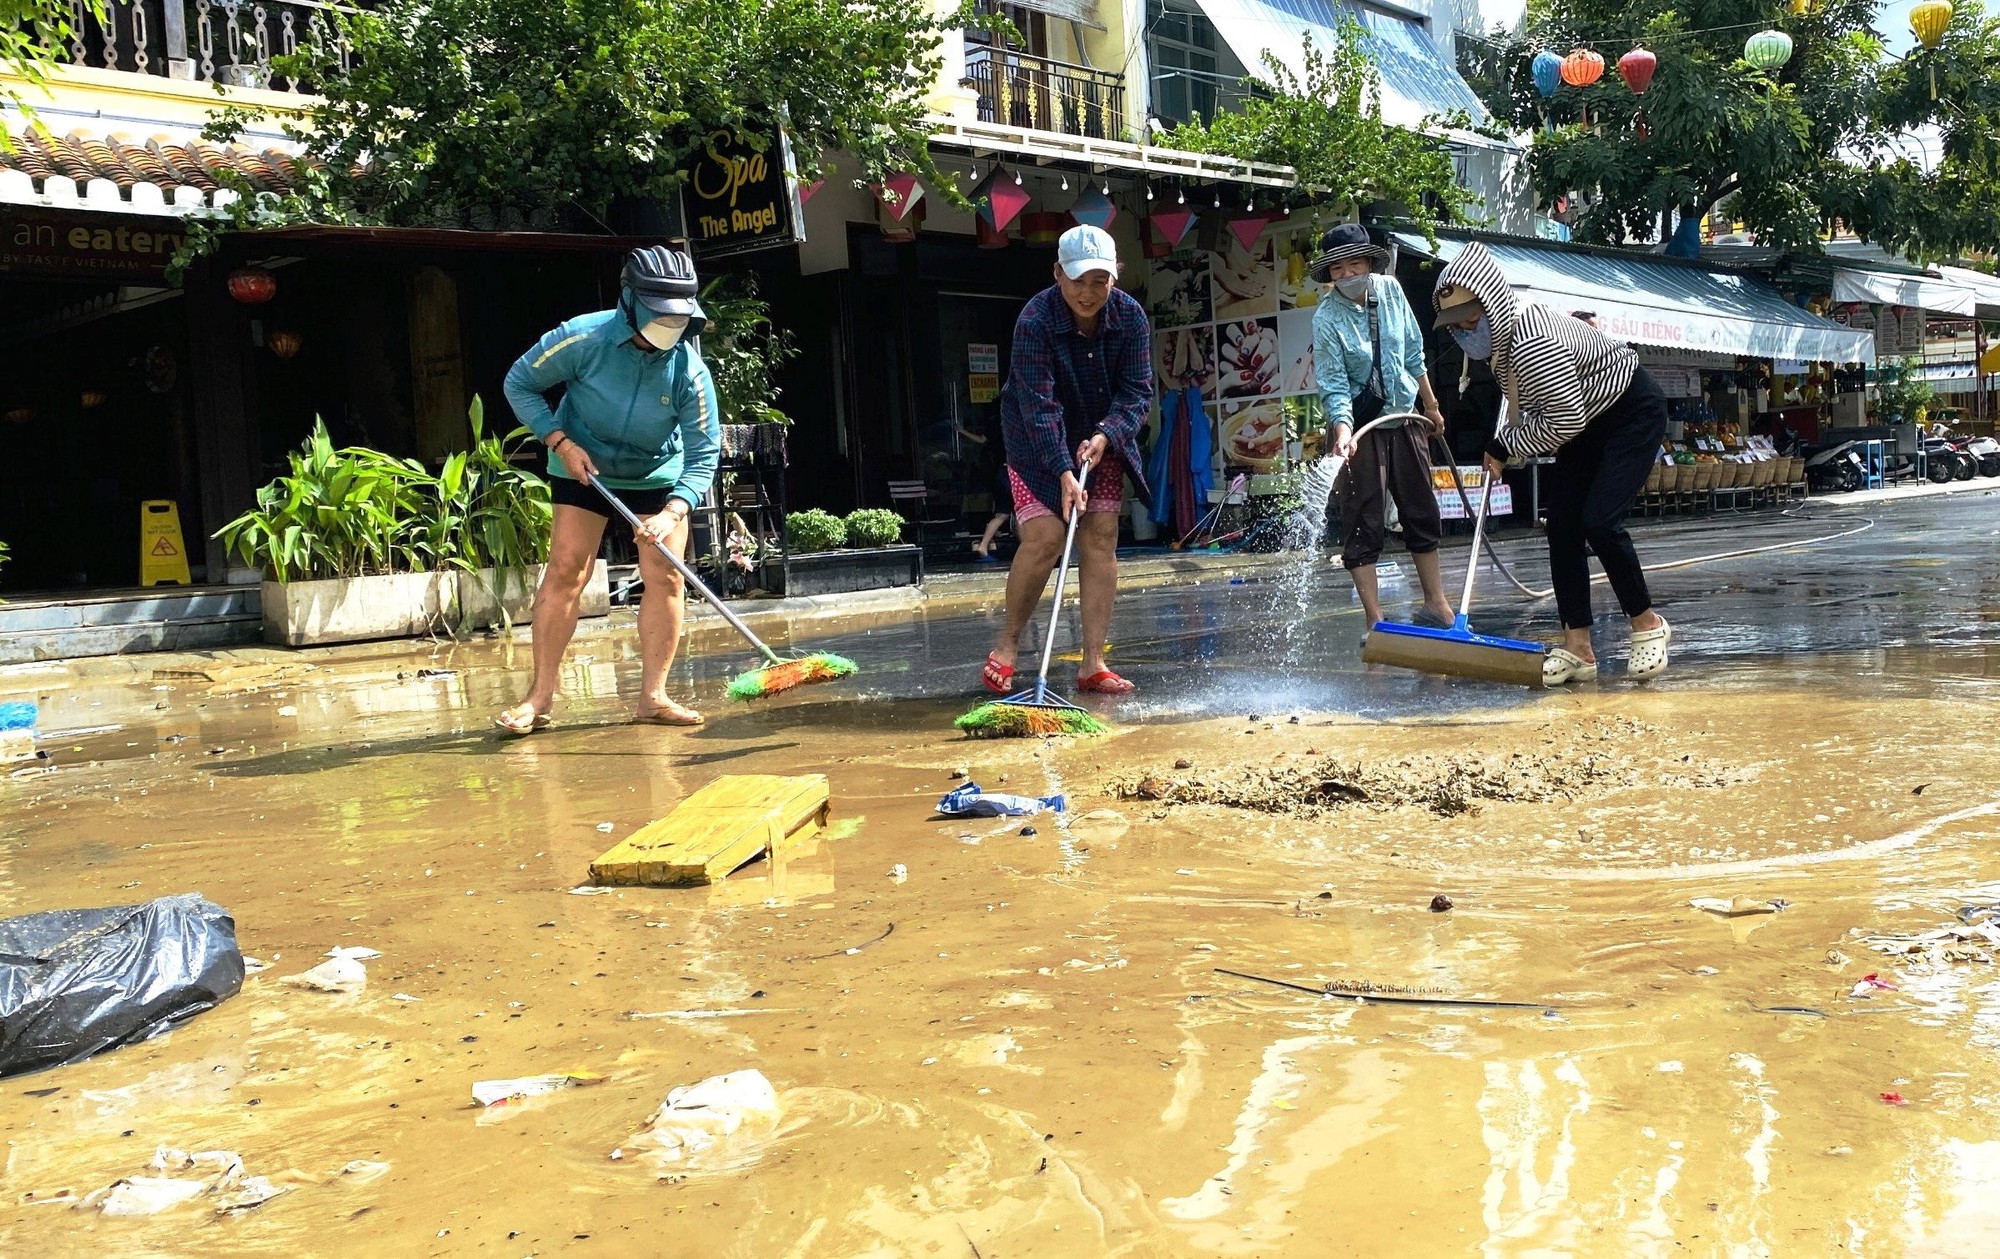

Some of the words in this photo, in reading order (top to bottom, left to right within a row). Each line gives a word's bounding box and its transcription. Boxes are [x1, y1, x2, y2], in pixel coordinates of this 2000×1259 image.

[694, 130, 768, 207] Spa
[699, 215, 728, 238] The
[732, 201, 777, 234] Angel
[13, 223, 56, 247] an
[67, 225, 190, 254] eatery
[2, 253, 19, 263] BY
[27, 254, 72, 266] TASTE
[75, 257, 139, 269] VIETNAM
[1612, 311, 1639, 337] SẦU
[1642, 319, 1682, 342] RIÊNG
